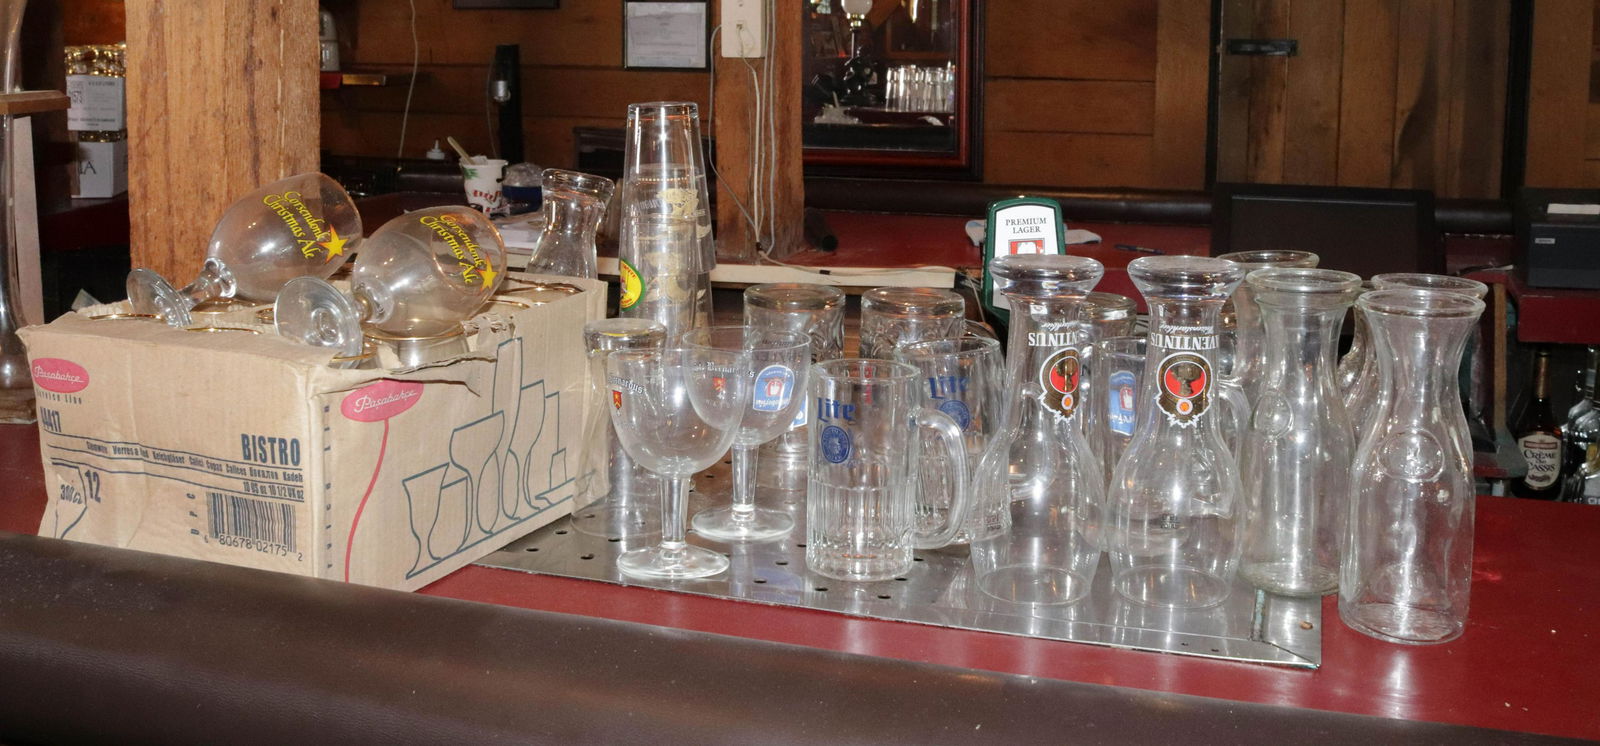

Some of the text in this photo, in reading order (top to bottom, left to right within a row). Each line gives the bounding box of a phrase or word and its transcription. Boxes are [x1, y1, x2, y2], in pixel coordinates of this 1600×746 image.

[263, 194, 319, 260] Christmas Ale
[284, 191, 331, 241] Corsendonk
[1005, 217, 1047, 226] PREMIUM
[1012, 225, 1041, 234] LAGER
[420, 215, 480, 284] Christmas Ale
[440, 214, 486, 267] Corsendonk
[928, 376, 970, 399] Lite
[817, 397, 856, 422] Lite
[240, 433, 301, 466] BISTRO
[85, 469, 102, 503] 12
[219, 534, 252, 549] 80678
[256, 540, 287, 557] 02175
[297, 552, 303, 561] 2
